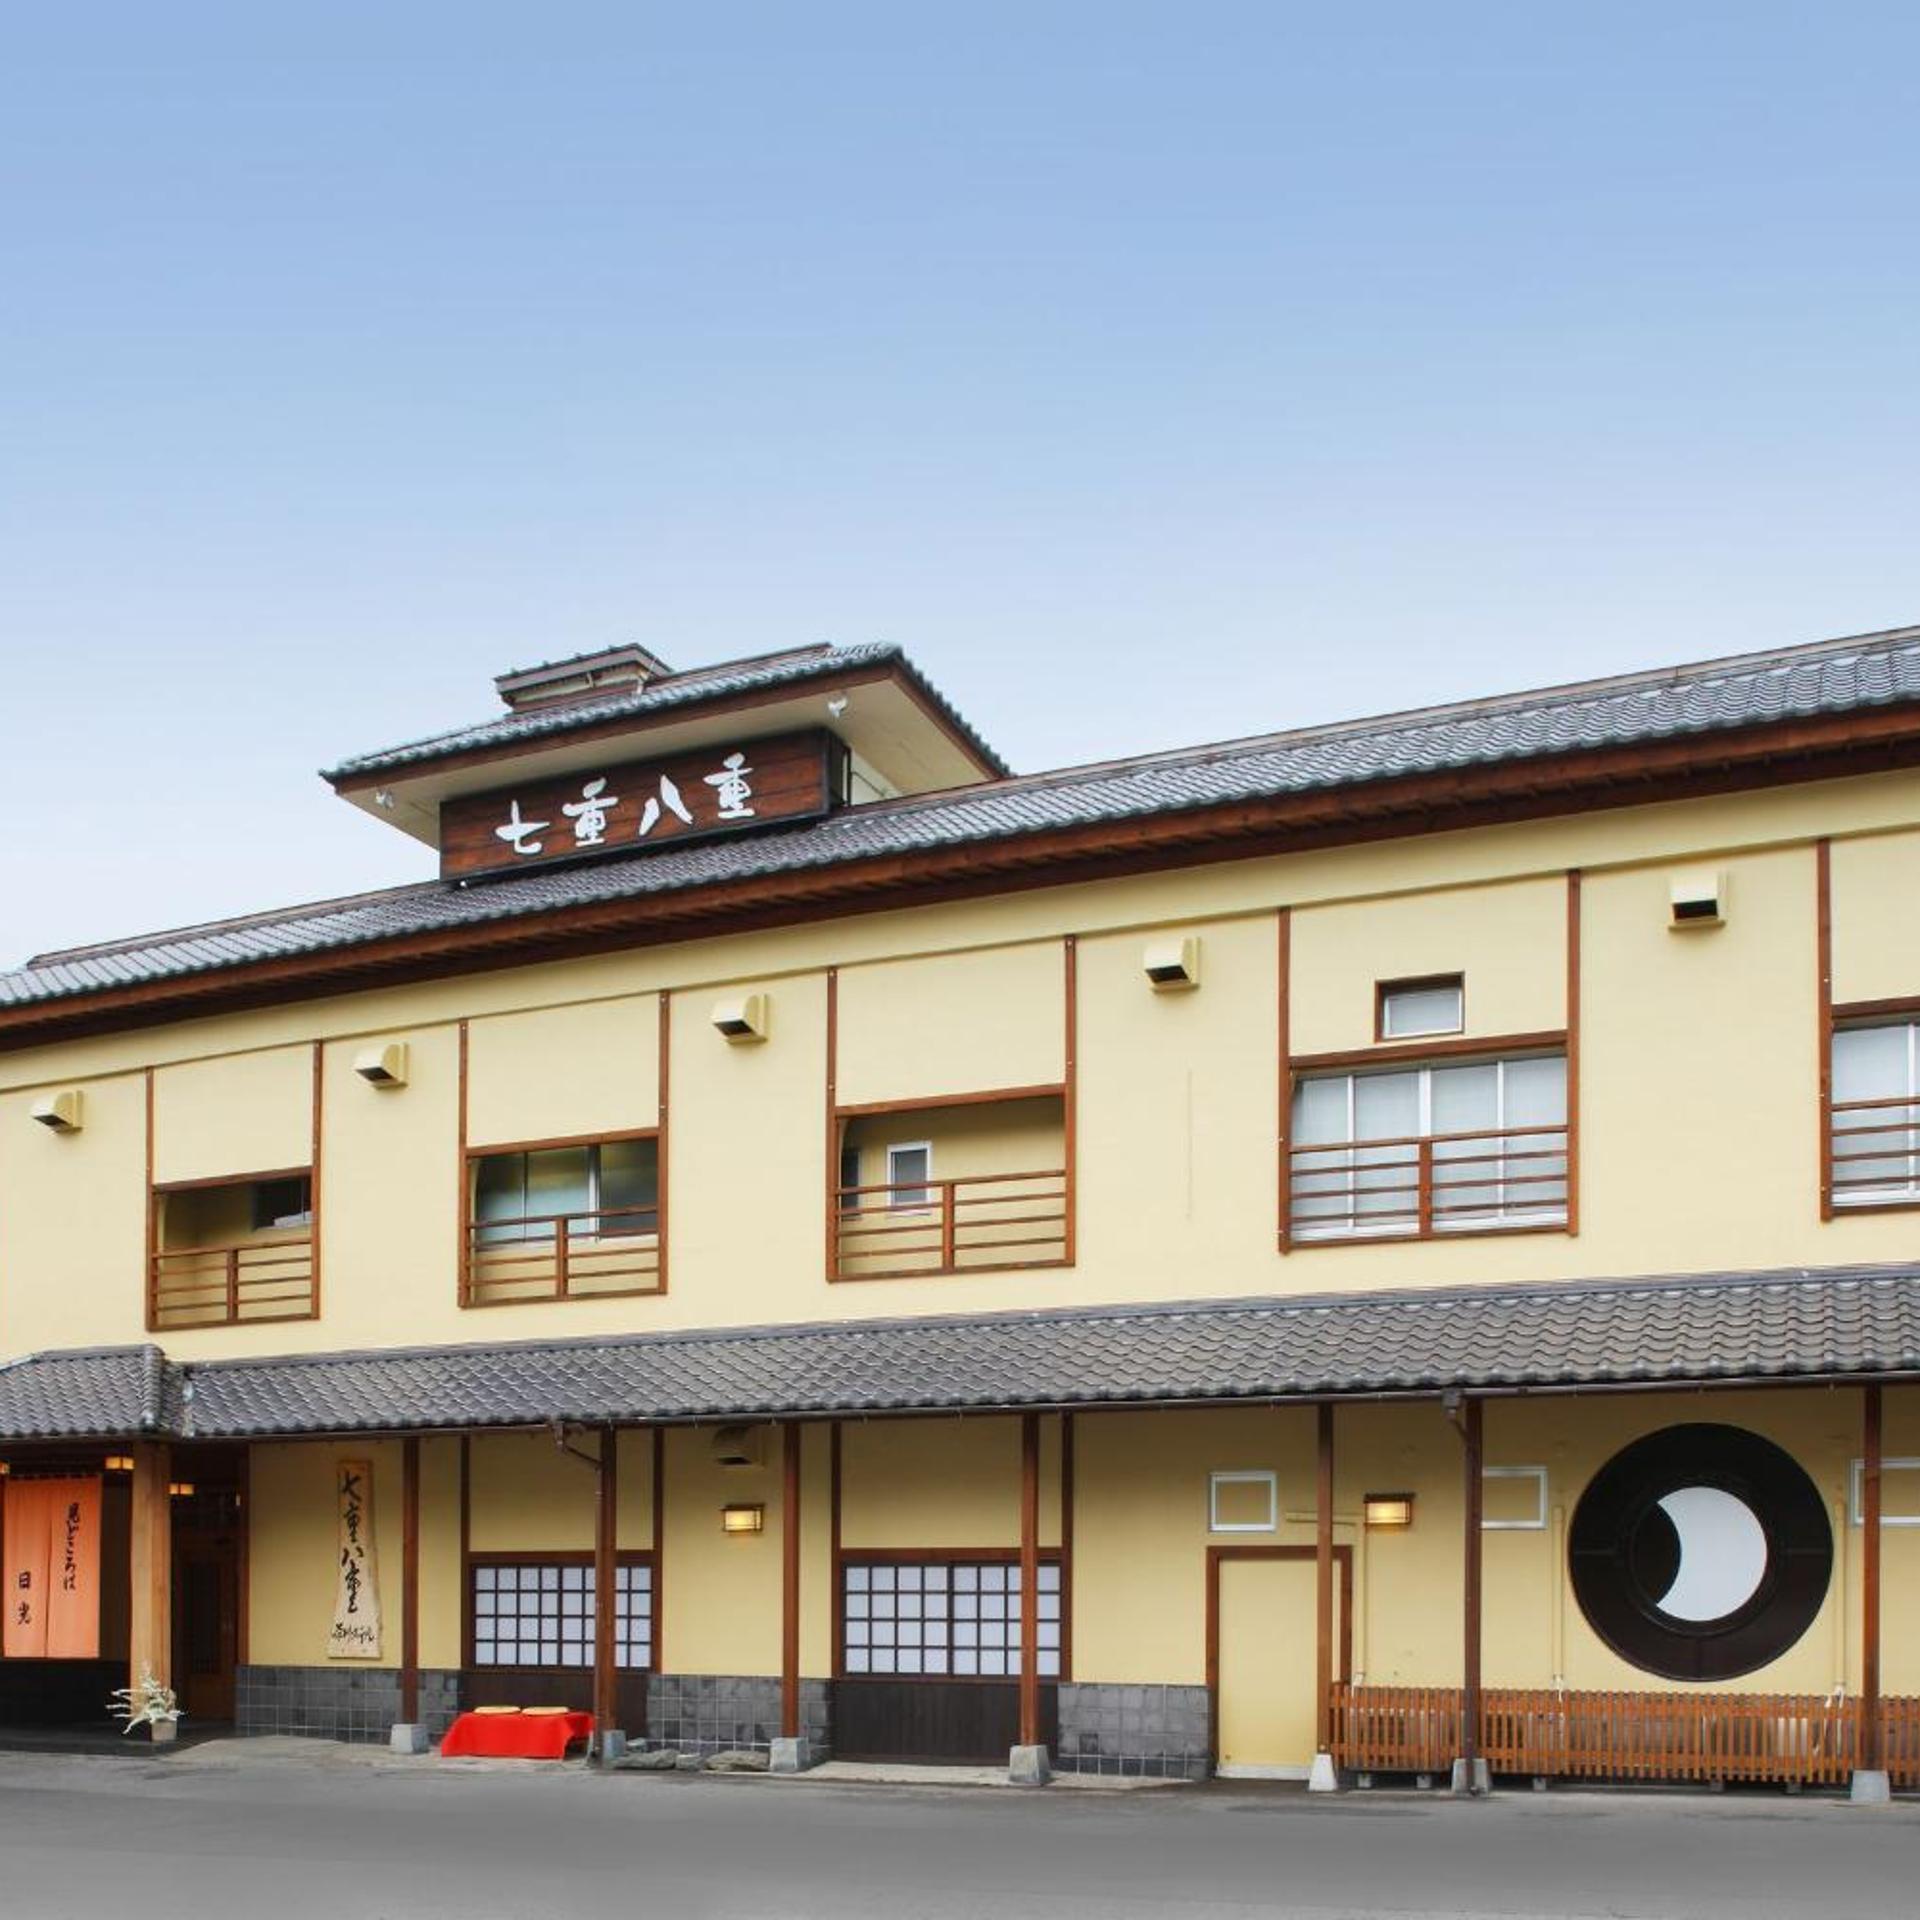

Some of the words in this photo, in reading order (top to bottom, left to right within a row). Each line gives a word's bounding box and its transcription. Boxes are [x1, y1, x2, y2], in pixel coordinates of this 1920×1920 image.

[494, 751, 756, 855] 七重八重
[18, 1571, 31, 1626] 日光
